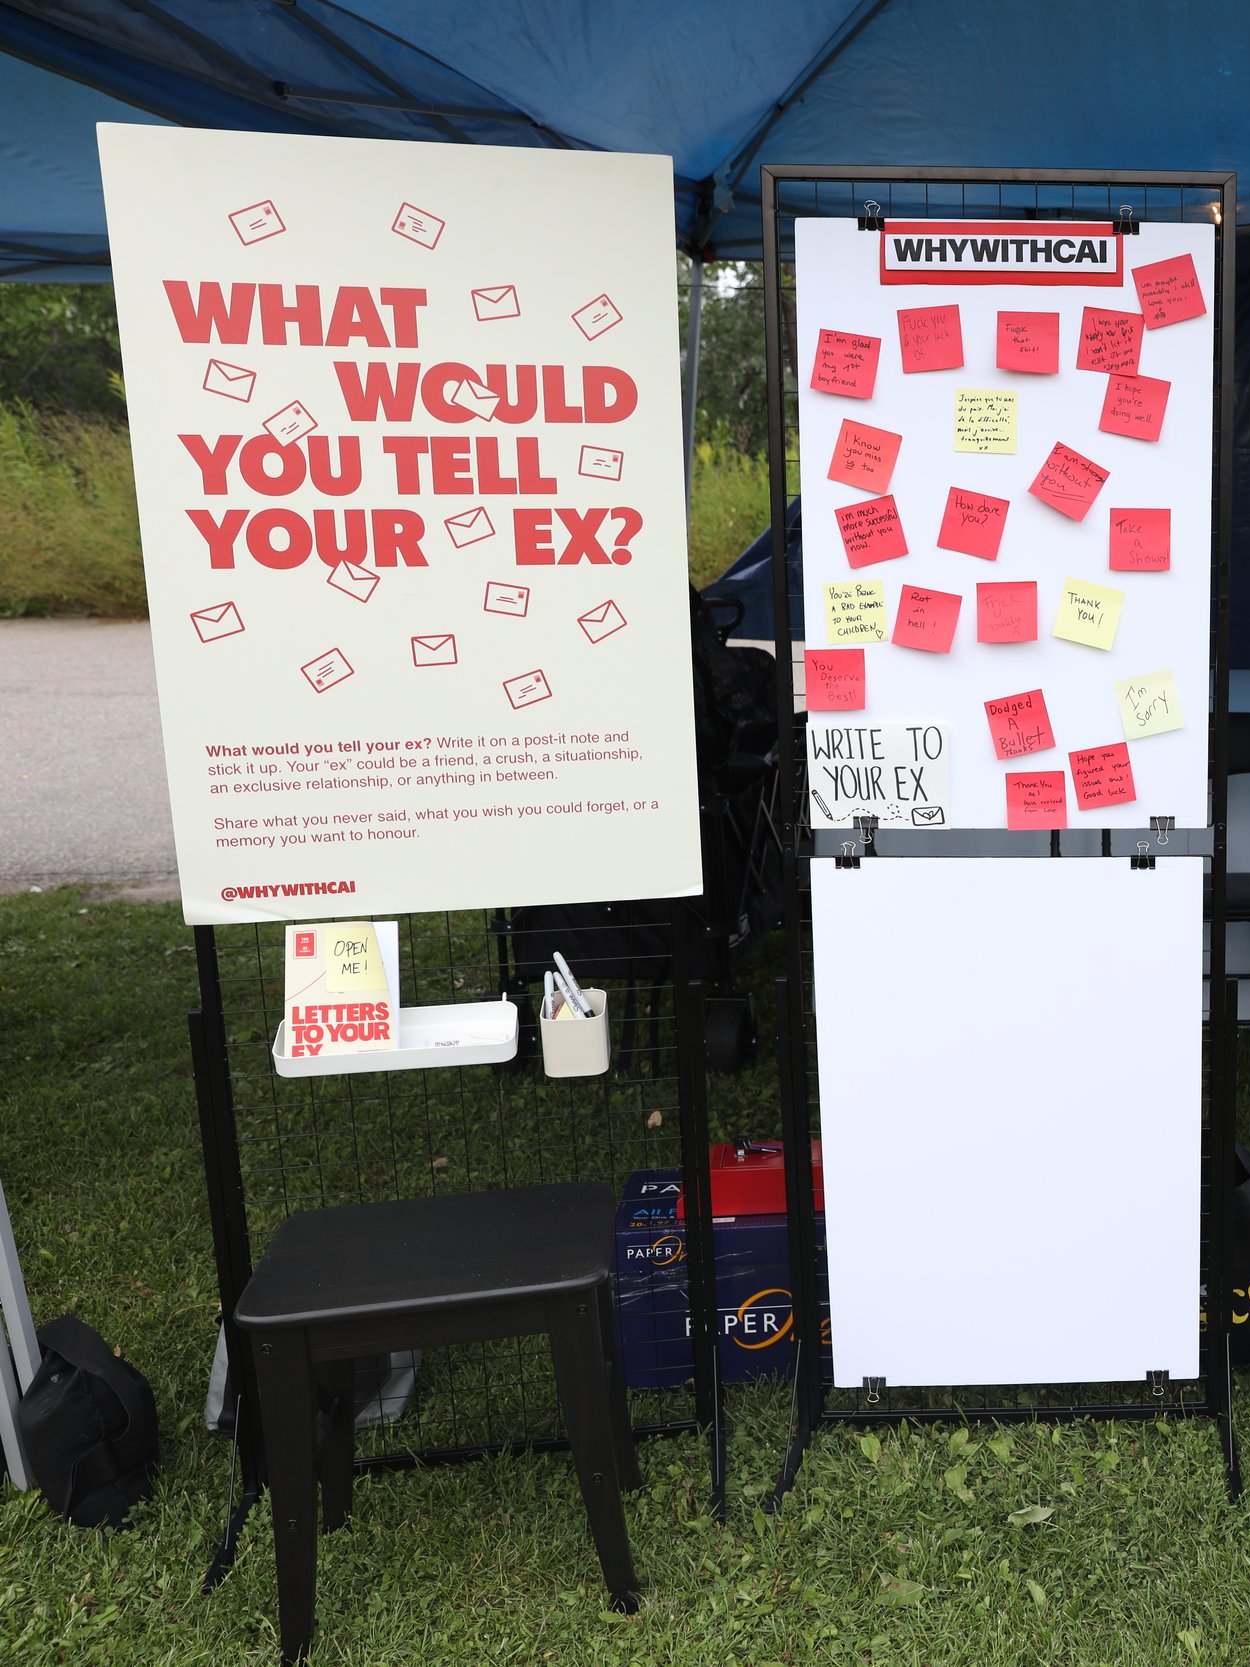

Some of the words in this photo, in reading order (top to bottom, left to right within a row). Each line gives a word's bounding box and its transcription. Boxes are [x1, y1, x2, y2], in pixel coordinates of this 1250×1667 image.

[894, 238, 1108, 264] WHYWITHCAI
[162, 280, 428, 348] WHAT
[852, 335, 871, 350] glad
[844, 352, 864, 361] were
[822, 362, 837, 373] my
[818, 373, 857, 388] boyfriend
[1115, 383, 1121, 391] I
[1124, 383, 1141, 395] hope
[334, 361, 638, 424] WOULD
[1117, 396, 1142, 407] you're
[1111, 407, 1131, 423] doing
[1135, 409, 1153, 423] well.
[843, 446, 862, 458] you
[865, 451, 882, 462] miss
[178, 434, 363, 496] YOU
[382, 436, 558, 496] TELL
[862, 463, 874, 473] too
[857, 505, 878, 517] much
[955, 495, 974, 511] How
[978, 500, 1001, 516] dare
[843, 519, 863, 532] more
[867, 508, 897, 527] successful
[961, 512, 988, 526] you?
[184, 508, 429, 570] YOUR
[512, 506, 644, 566] EX?
[845, 528, 874, 545] without
[877, 526, 893, 539] you
[850, 542, 871, 552] now.
[911, 592, 931, 602] Rot
[1068, 591, 1101, 610] THANK
[913, 606, 925, 614] in
[990, 695, 1033, 716] Dodged
[1125, 685, 1148, 711] I'm
[1008, 717, 1019, 730] A
[206, 745, 247, 757] What
[252, 743, 299, 756] would
[304, 743, 333, 756] you
[338, 740, 361, 753] tell
[366, 740, 400, 754] your
[405, 737, 432, 750] ex?
[437, 736, 473, 749] Write
[478, 735, 485, 747] it
[490, 736, 507, 747] on
[511, 736, 520, 746] a
[525, 732, 566, 749] post-it
[571, 732, 600, 744] note
[604, 731, 629, 743] and
[811, 728, 885, 760] WRITE
[906, 726, 942, 761] TO
[208, 762, 241, 776] stick
[246, 762, 255, 774] it
[259, 763, 282, 776] up.
[287, 760, 320, 773] Your
[357, 757, 395, 770] could
[399, 756, 417, 768] be
[422, 757, 430, 767] a
[435, 754, 478, 768] friend,
[483, 755, 491, 765] a
[496, 752, 537, 765] crush,
[542, 752, 550, 762] a
[555, 747, 643, 762] situationship,
[210, 783, 228, 794] an
[233, 779, 301, 793] exclusive
[306, 775, 393, 790] relationship,
[397, 776, 411, 786] or
[417, 772, 475, 787] anything
[480, 771, 492, 782] in
[496, 769, 559, 782] between.
[823, 764, 886, 801] YOUR
[894, 766, 928, 802] EX
[214, 816, 258, 830] Share
[263, 815, 297, 827] what
[302, 815, 328, 828] you
[333, 813, 373, 824] never
[377, 810, 411, 823] said,
[415, 808, 449, 820] what
[453, 809, 478, 821] you
[482, 804, 513, 817] wish
[518, 806, 542, 818] you
[546, 801, 582, 814] could
[587, 799, 629, 814] forget,
[633, 799, 647, 810] or
[651, 799, 659, 810] a
[216, 834, 275, 848] memory
[280, 834, 306, 847] you
[311, 831, 346, 843] want
[350, 830, 363, 841] to
[368, 827, 420, 840] honour.
[221, 880, 356, 902] @WHYWITHCAI
[333, 937, 368, 958] OPEN
[292, 1002, 389, 1025] LETTERS
[292, 1025, 324, 1044] TO
[328, 1023, 390, 1042] YOUR
